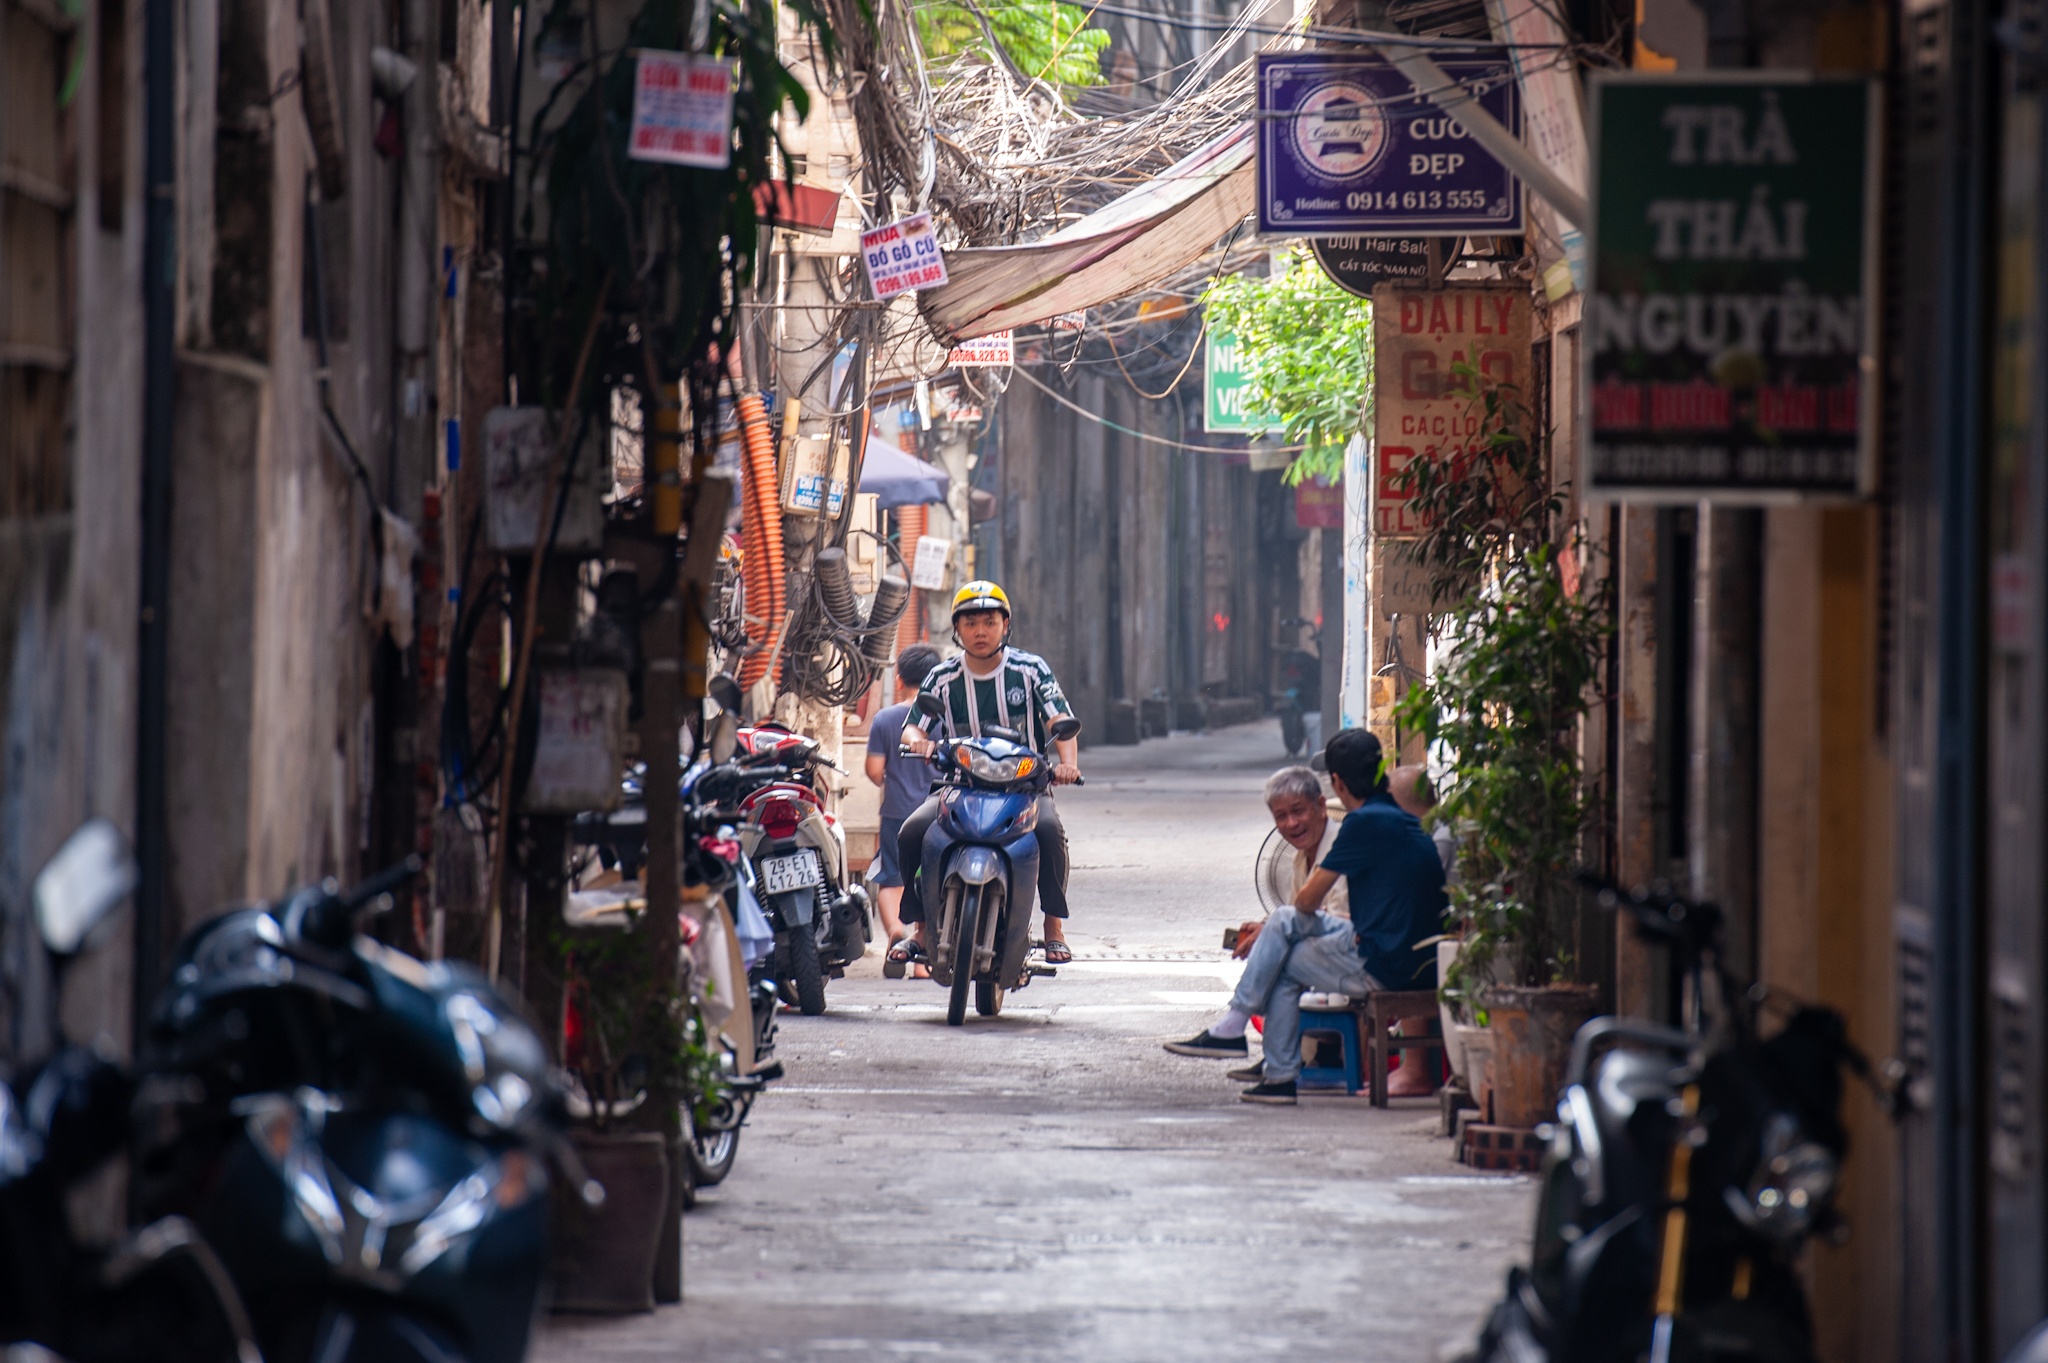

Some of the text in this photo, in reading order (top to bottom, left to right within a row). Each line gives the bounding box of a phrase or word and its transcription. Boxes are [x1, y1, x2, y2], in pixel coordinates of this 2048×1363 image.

[1409, 153, 1465, 181] ĐẸP
[1295, 190, 1486, 211] Hotline: 0914 613 555
[1646, 184, 1808, 260] THÁI
[864, 226, 900, 248] MUA
[1366, 238, 1397, 253] Hair
[1594, 276, 1859, 356] NGUYÊN
[770, 855, 808, 876] 29-E1
[770, 870, 815, 891] 412.26
